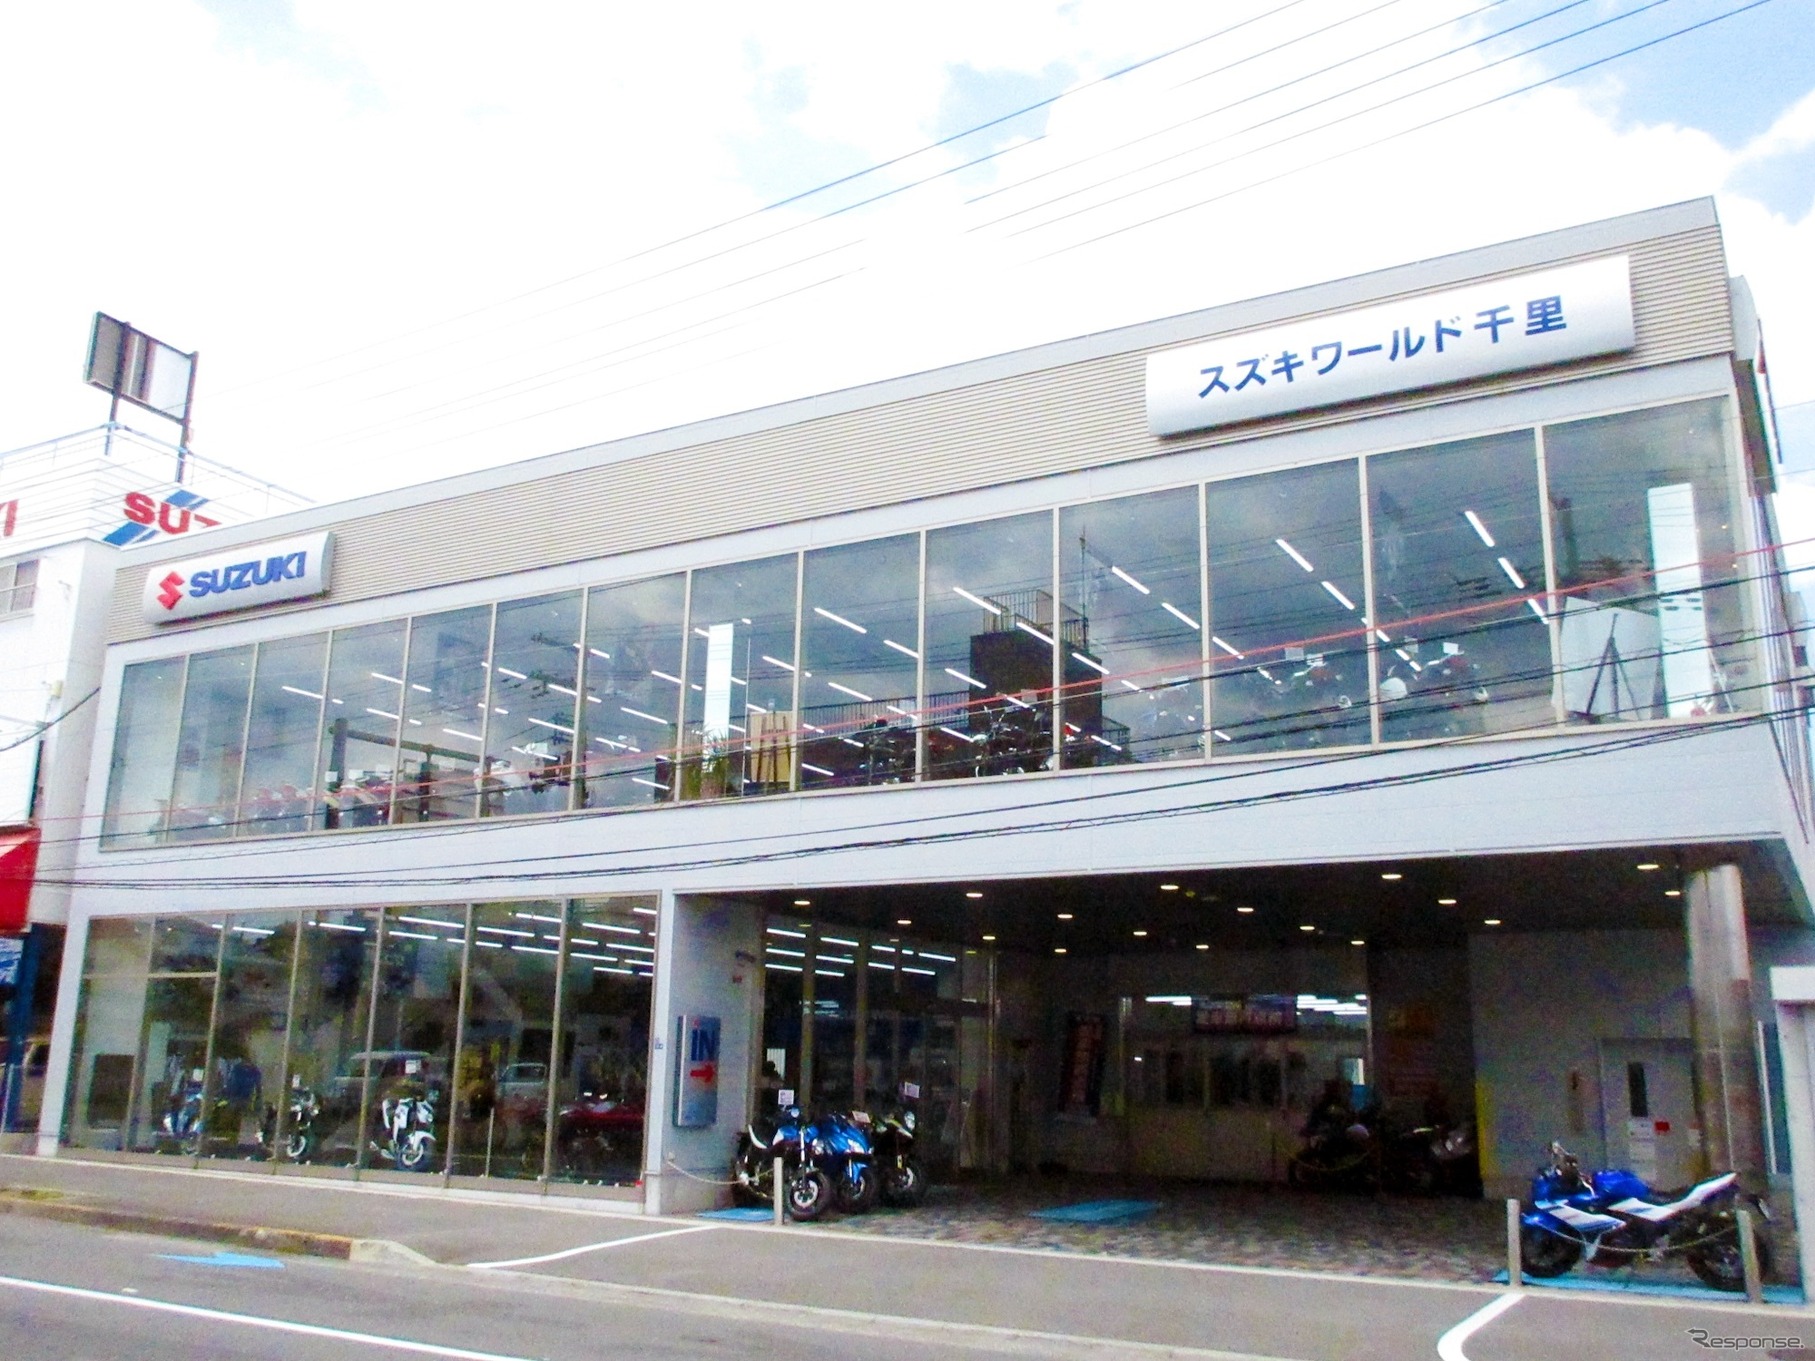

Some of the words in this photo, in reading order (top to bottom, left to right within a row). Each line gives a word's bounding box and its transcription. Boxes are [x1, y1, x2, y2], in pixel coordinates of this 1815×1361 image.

[1198, 295, 1567, 399] スズキワールド千里
[189, 551, 308, 598] SUZUKI
[691, 1029, 718, 1061] IN
